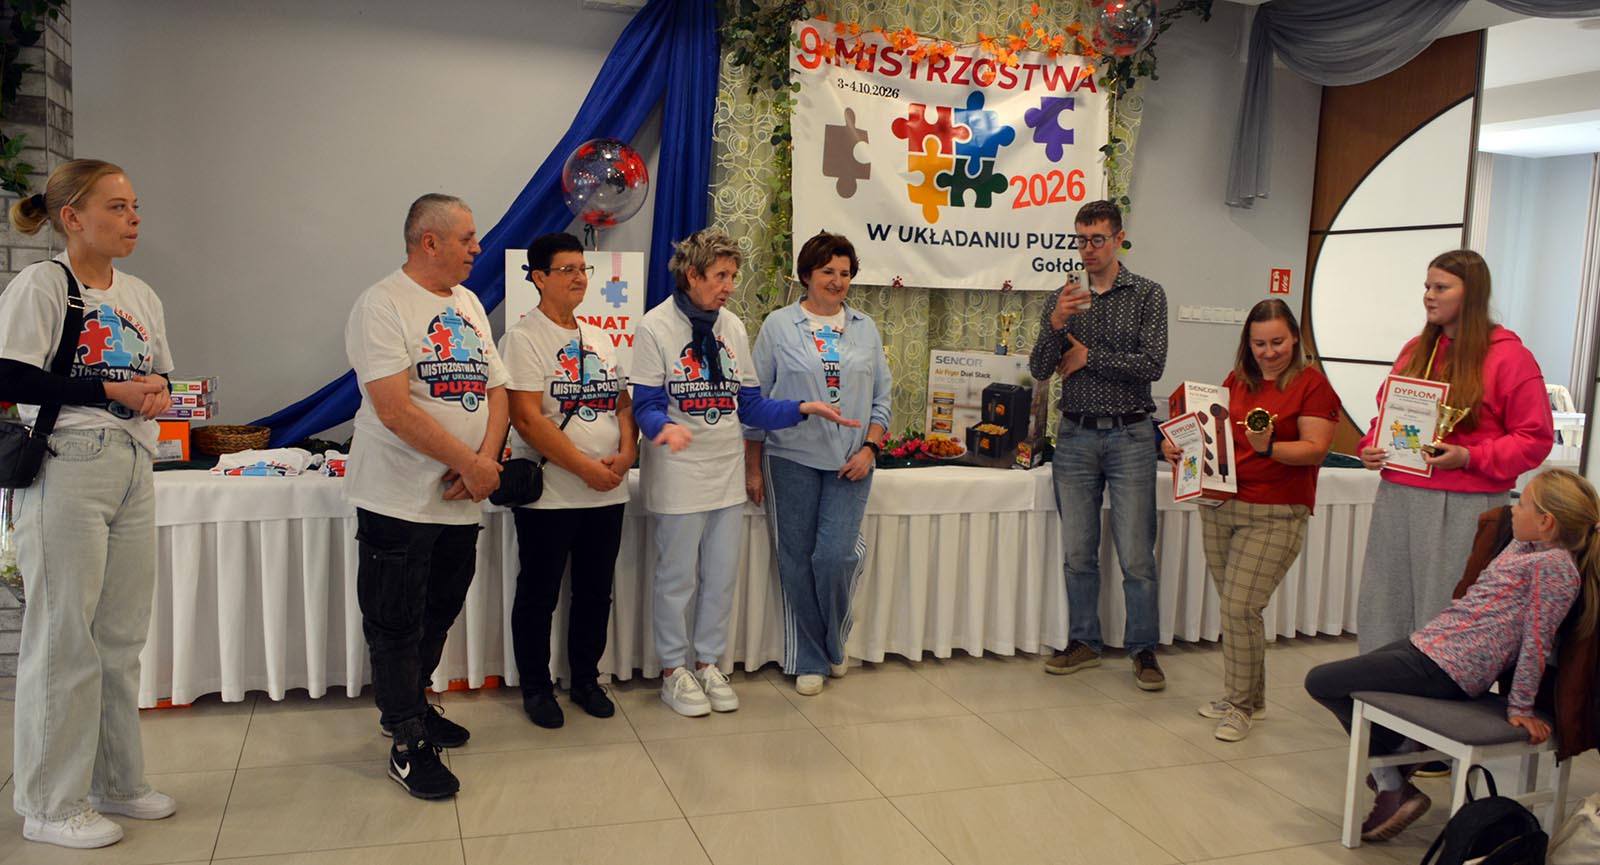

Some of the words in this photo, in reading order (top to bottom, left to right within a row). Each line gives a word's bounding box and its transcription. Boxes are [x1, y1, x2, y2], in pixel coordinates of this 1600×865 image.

[835, 38, 1097, 93] MISTRZOSTWA
[1009, 169, 1086, 209] 2026
[867, 223, 892, 241] W
[898, 225, 1020, 249] UKŁADANIU
[1026, 233, 1078, 250] PUZZ
[936, 355, 983, 367] SENCOR
[1394, 387, 1436, 400] DYPLOM
